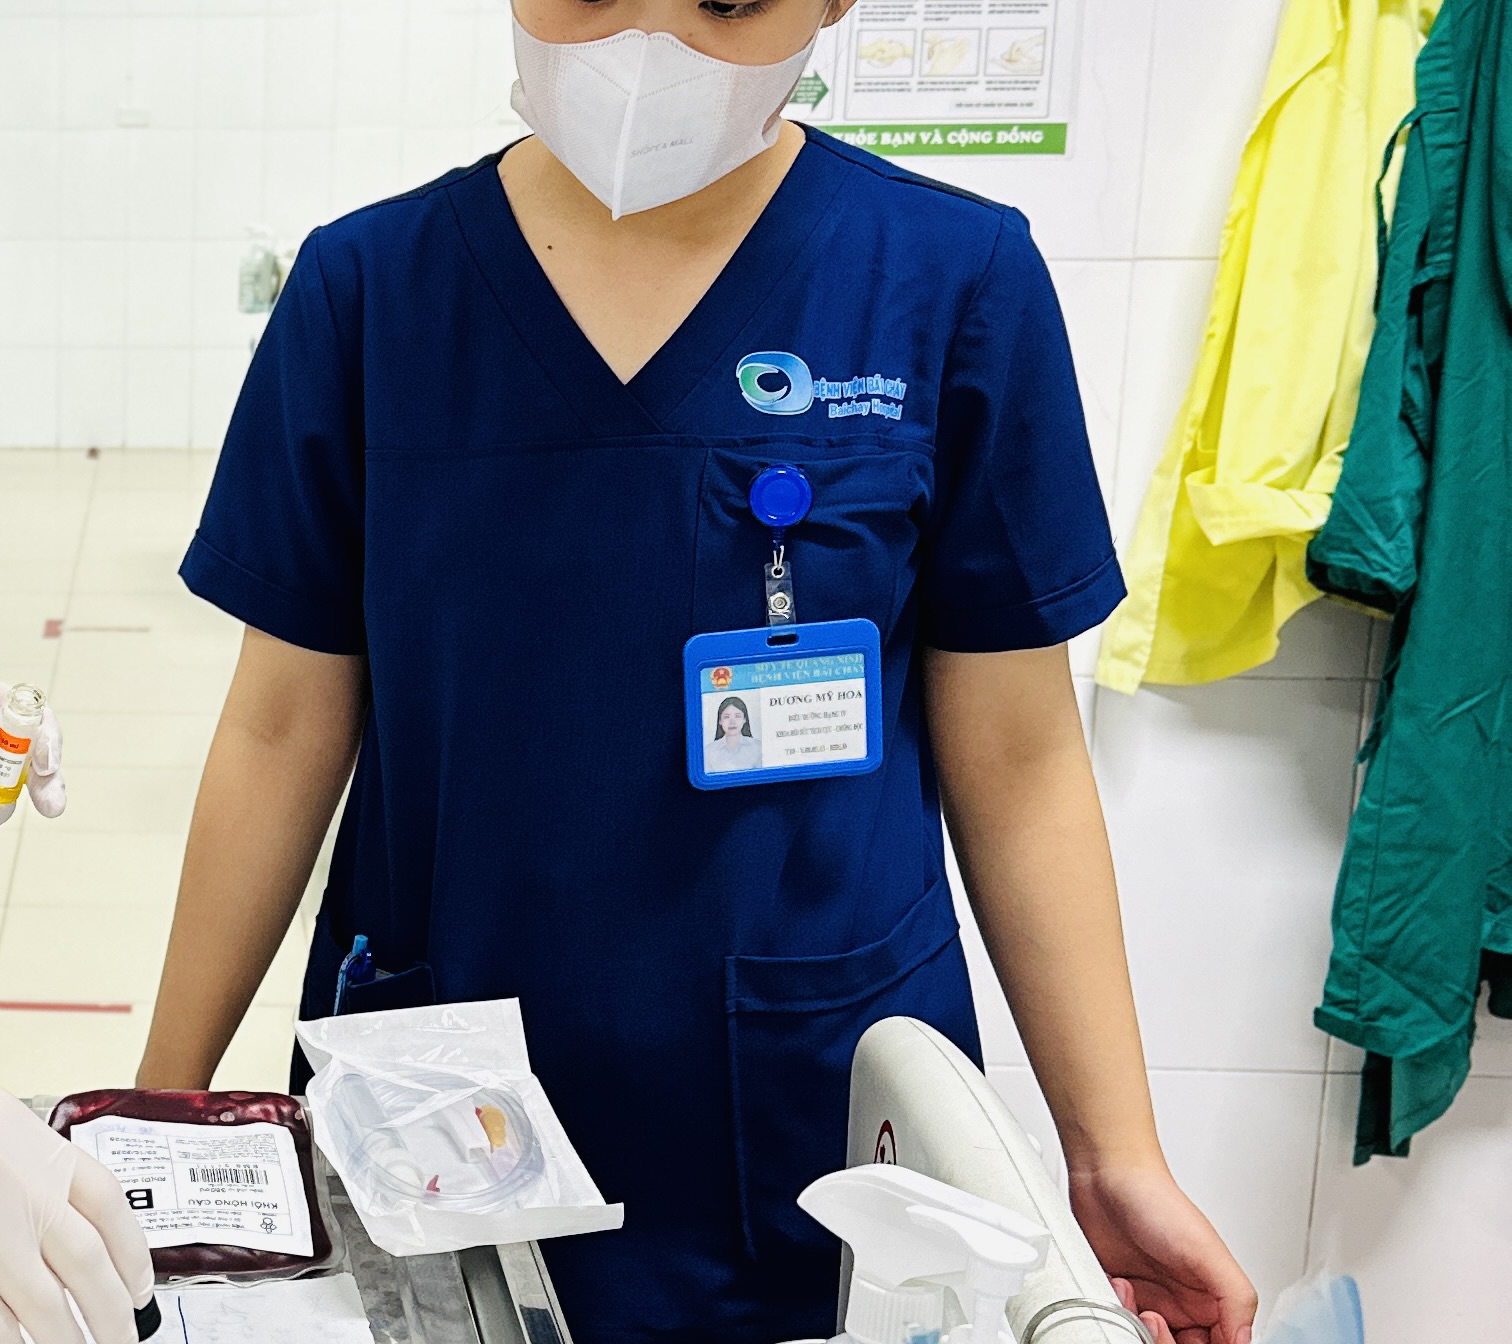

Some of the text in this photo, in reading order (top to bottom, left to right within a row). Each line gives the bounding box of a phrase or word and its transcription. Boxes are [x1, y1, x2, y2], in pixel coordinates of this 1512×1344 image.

[881, 131, 916, 149] BẠN
[919, 128, 943, 145] VÀ
[946, 129, 992, 149] CỘNG
[125, 1188, 154, 1210] B
